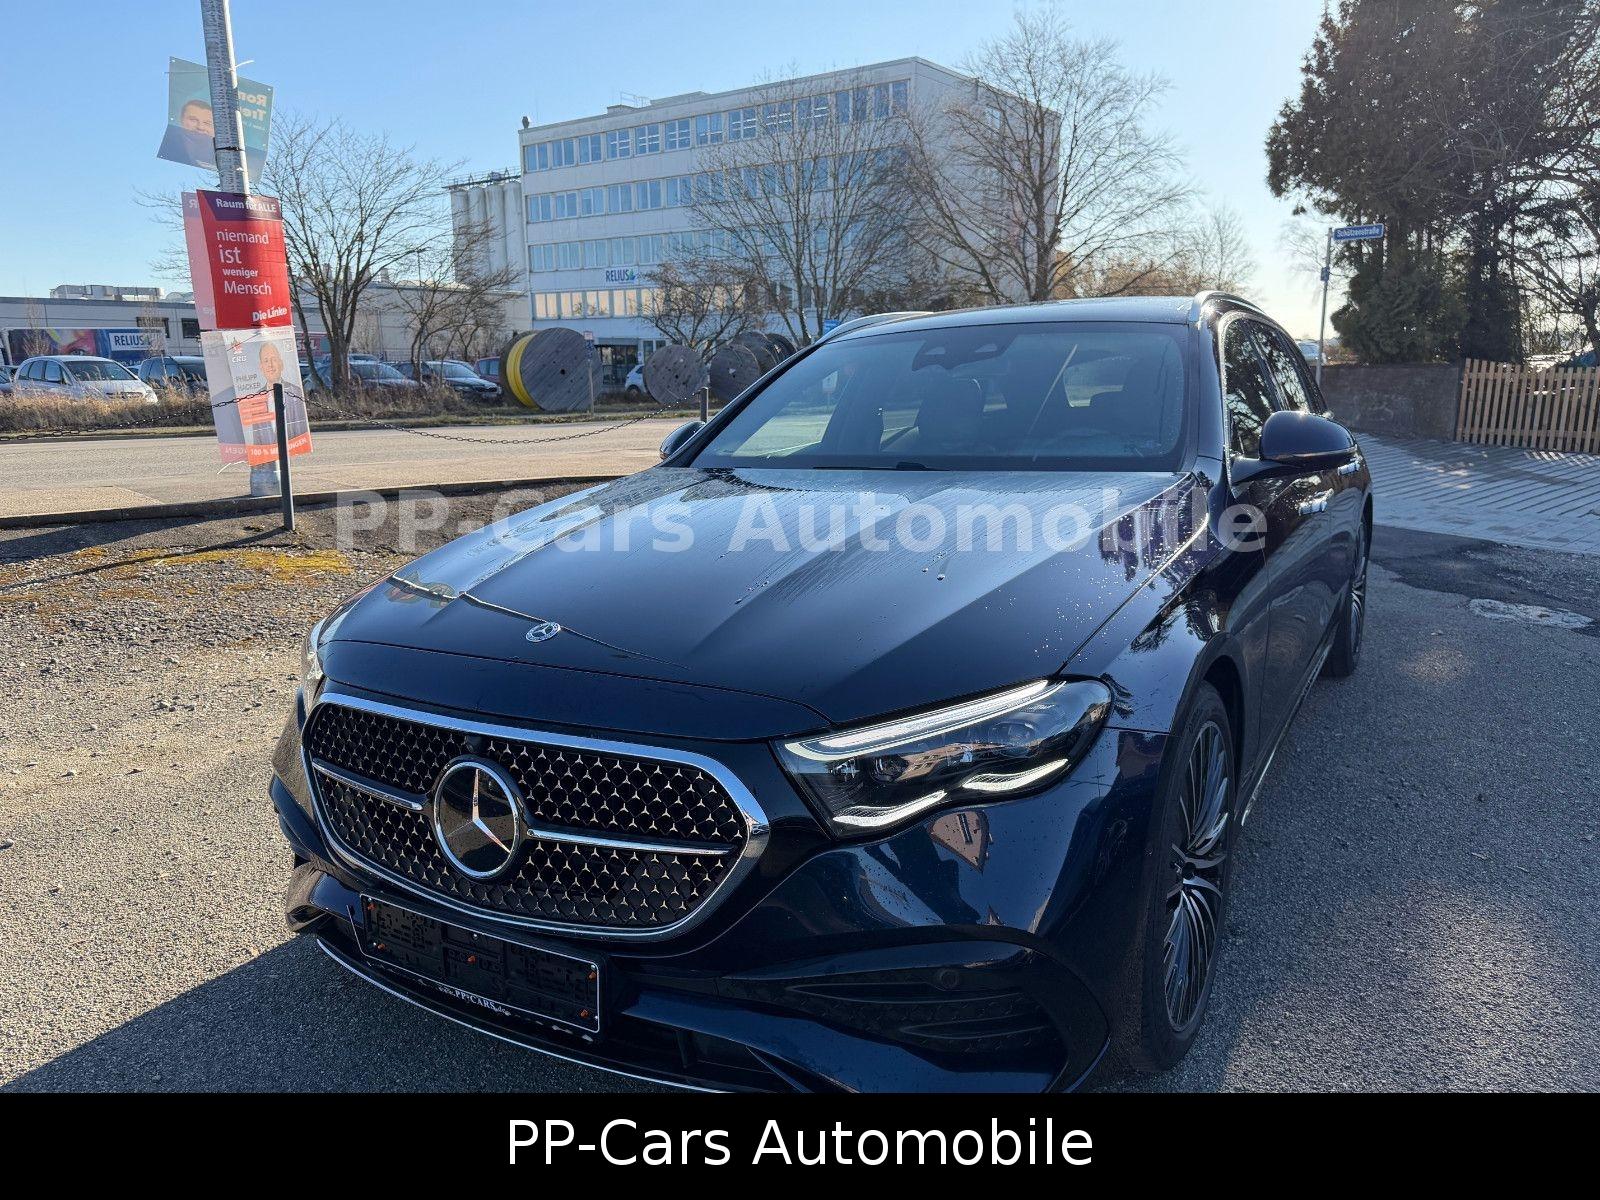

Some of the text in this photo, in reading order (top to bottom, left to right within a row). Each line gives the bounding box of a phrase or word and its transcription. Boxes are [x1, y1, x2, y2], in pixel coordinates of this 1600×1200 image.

[215, 198, 245, 209] Raum
[257, 202, 277, 213] ALLE
[216, 228, 270, 244] niemand
[219, 244, 242, 264] ist
[222, 267, 259, 279] weniger
[605, 268, 629, 282] RELIUS
[224, 281, 272, 295] Mensch
[252, 305, 288, 322] Die Linke
[114, 334, 144, 346] RELIUS
[250, 448, 262, 456] 100
